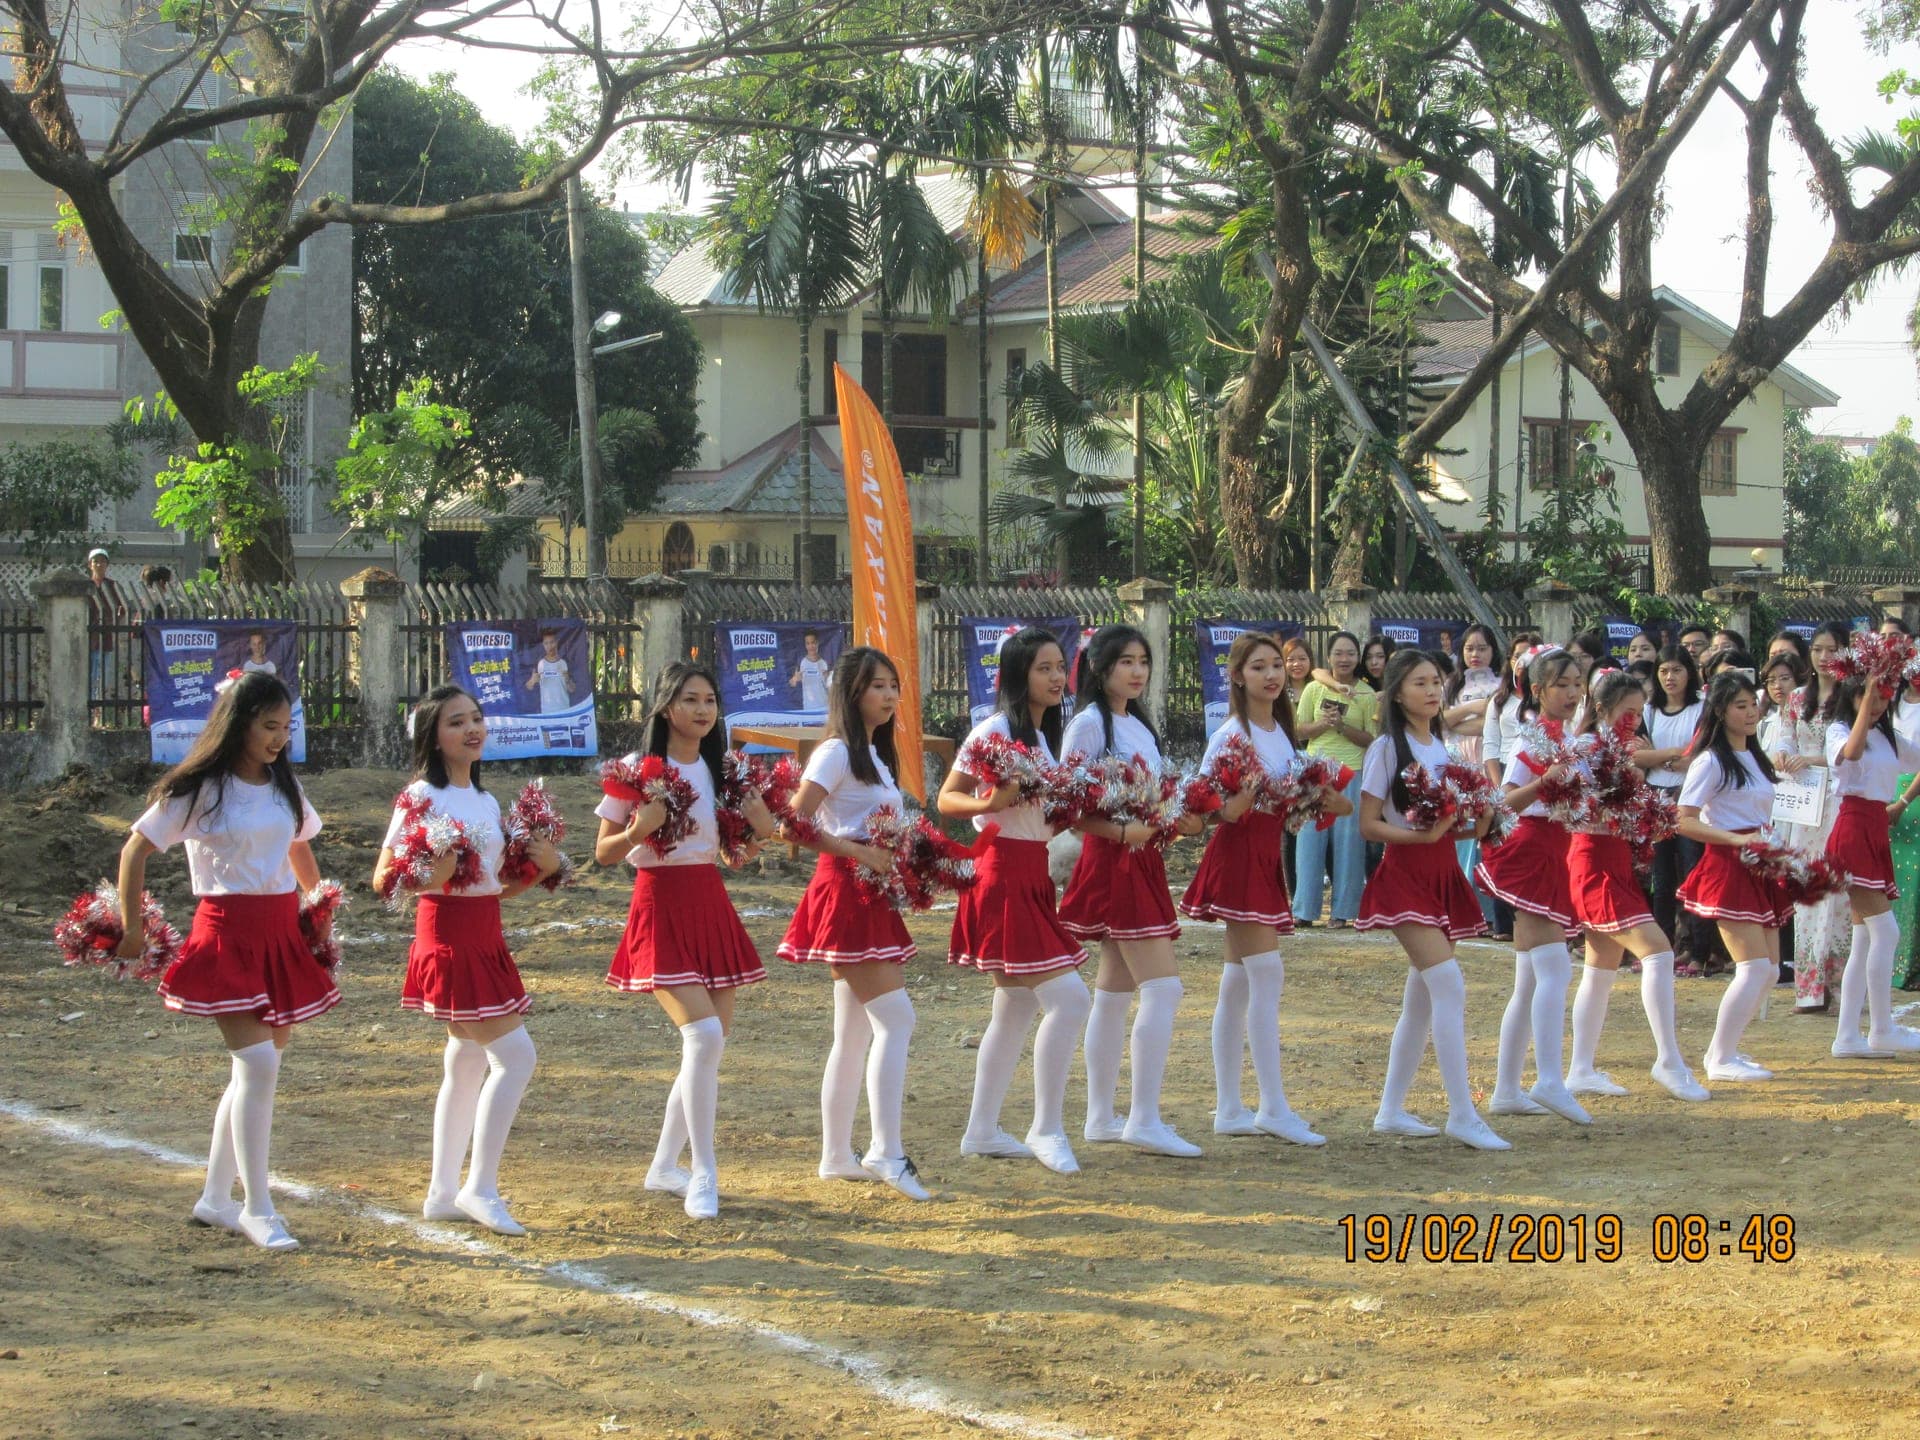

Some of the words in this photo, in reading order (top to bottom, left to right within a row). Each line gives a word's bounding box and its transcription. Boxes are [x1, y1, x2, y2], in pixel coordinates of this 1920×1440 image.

[165, 633, 215, 647] BIOGESIC
[466, 634, 511, 647] BIOGESIC
[733, 633, 775, 646] BIOGESIC
[1213, 630, 1240, 641] BIOG
[1385, 629, 1417, 641] BIOGESIC
